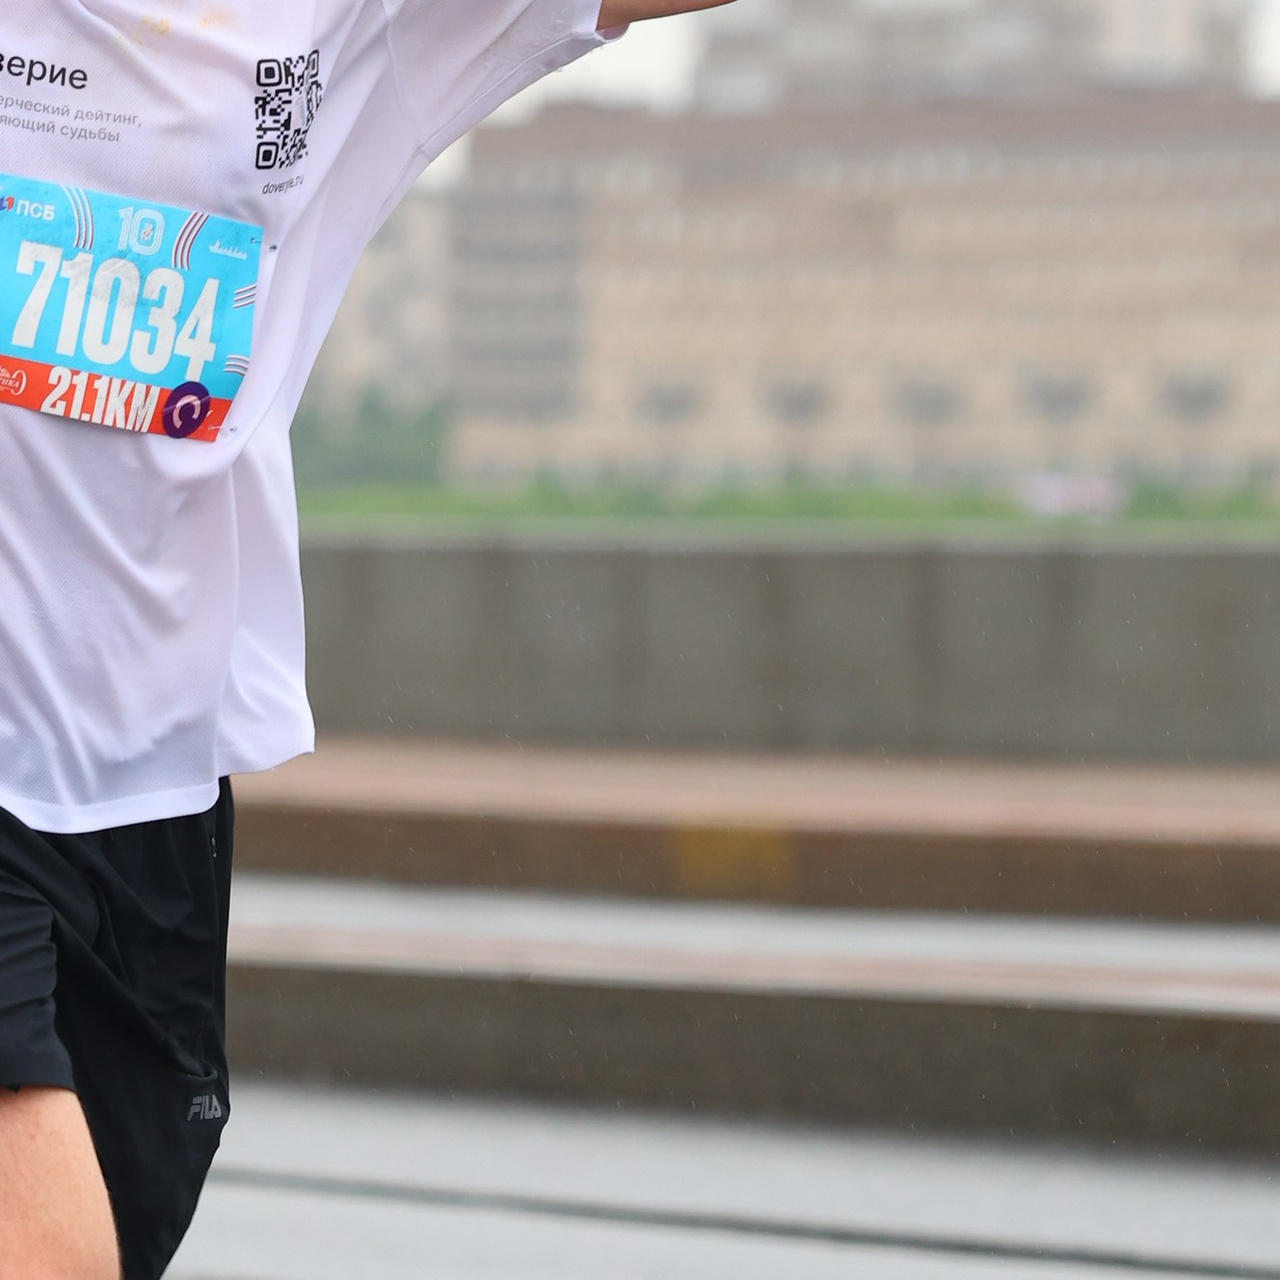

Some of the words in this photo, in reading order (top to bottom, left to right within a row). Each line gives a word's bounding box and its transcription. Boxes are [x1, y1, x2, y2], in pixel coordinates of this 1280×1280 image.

[73, 108, 143, 129] дейтинг,
[59, 123, 121, 143] судьбы
[16, 199, 56, 221] ПСБ
[117, 205, 166, 256] 10
[11, 241, 220, 384] 71034
[187, 1094, 222, 1121] FILA
